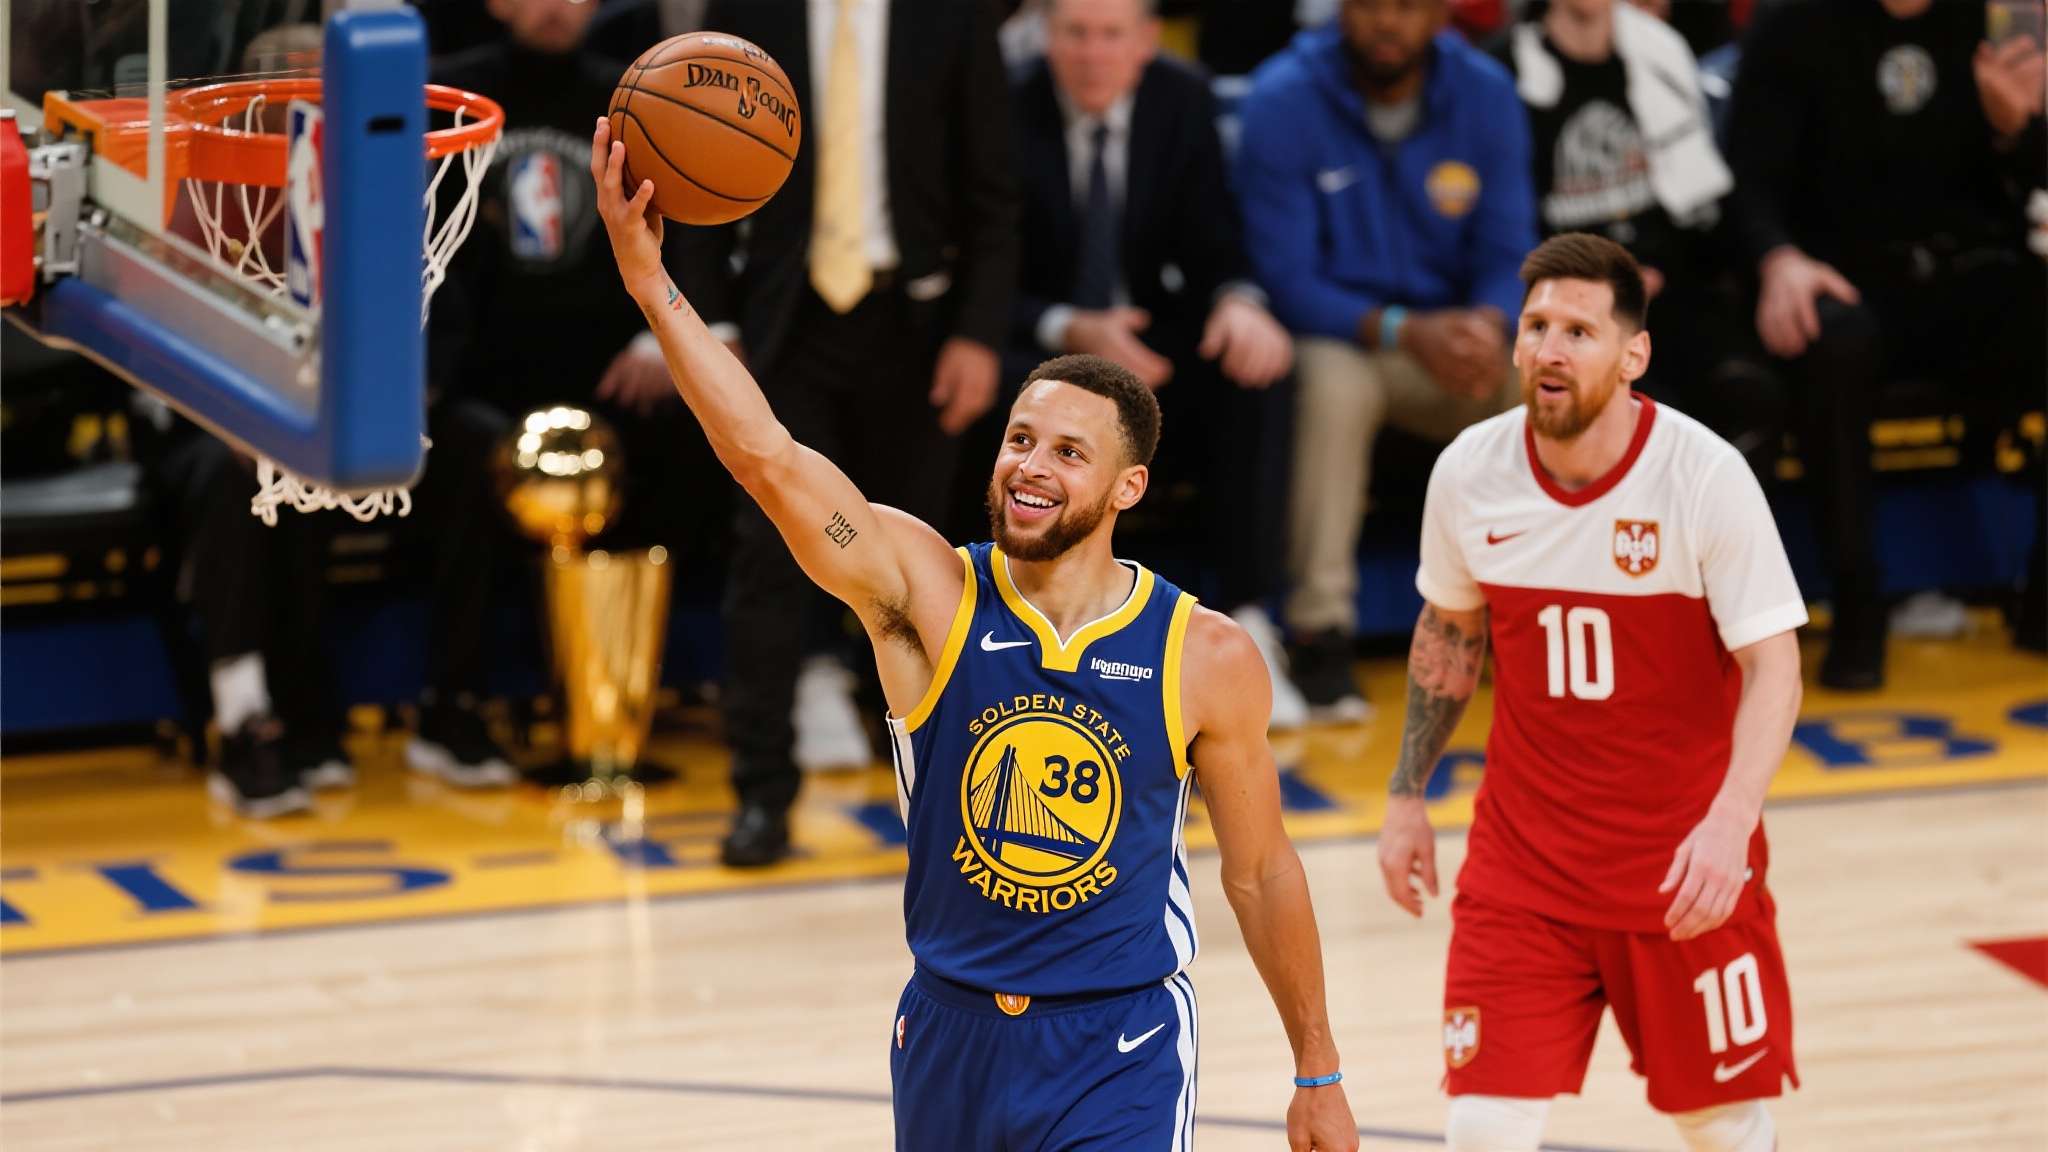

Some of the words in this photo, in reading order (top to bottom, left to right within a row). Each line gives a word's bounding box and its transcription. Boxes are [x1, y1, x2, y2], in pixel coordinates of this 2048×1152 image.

[1537, 604, 1615, 701] 10
[1072, 703, 1132, 762] STATE
[1039, 755, 1101, 804] 38
[952, 835, 1119, 914] WARRIORS
[1693, 952, 1768, 1055] 10
